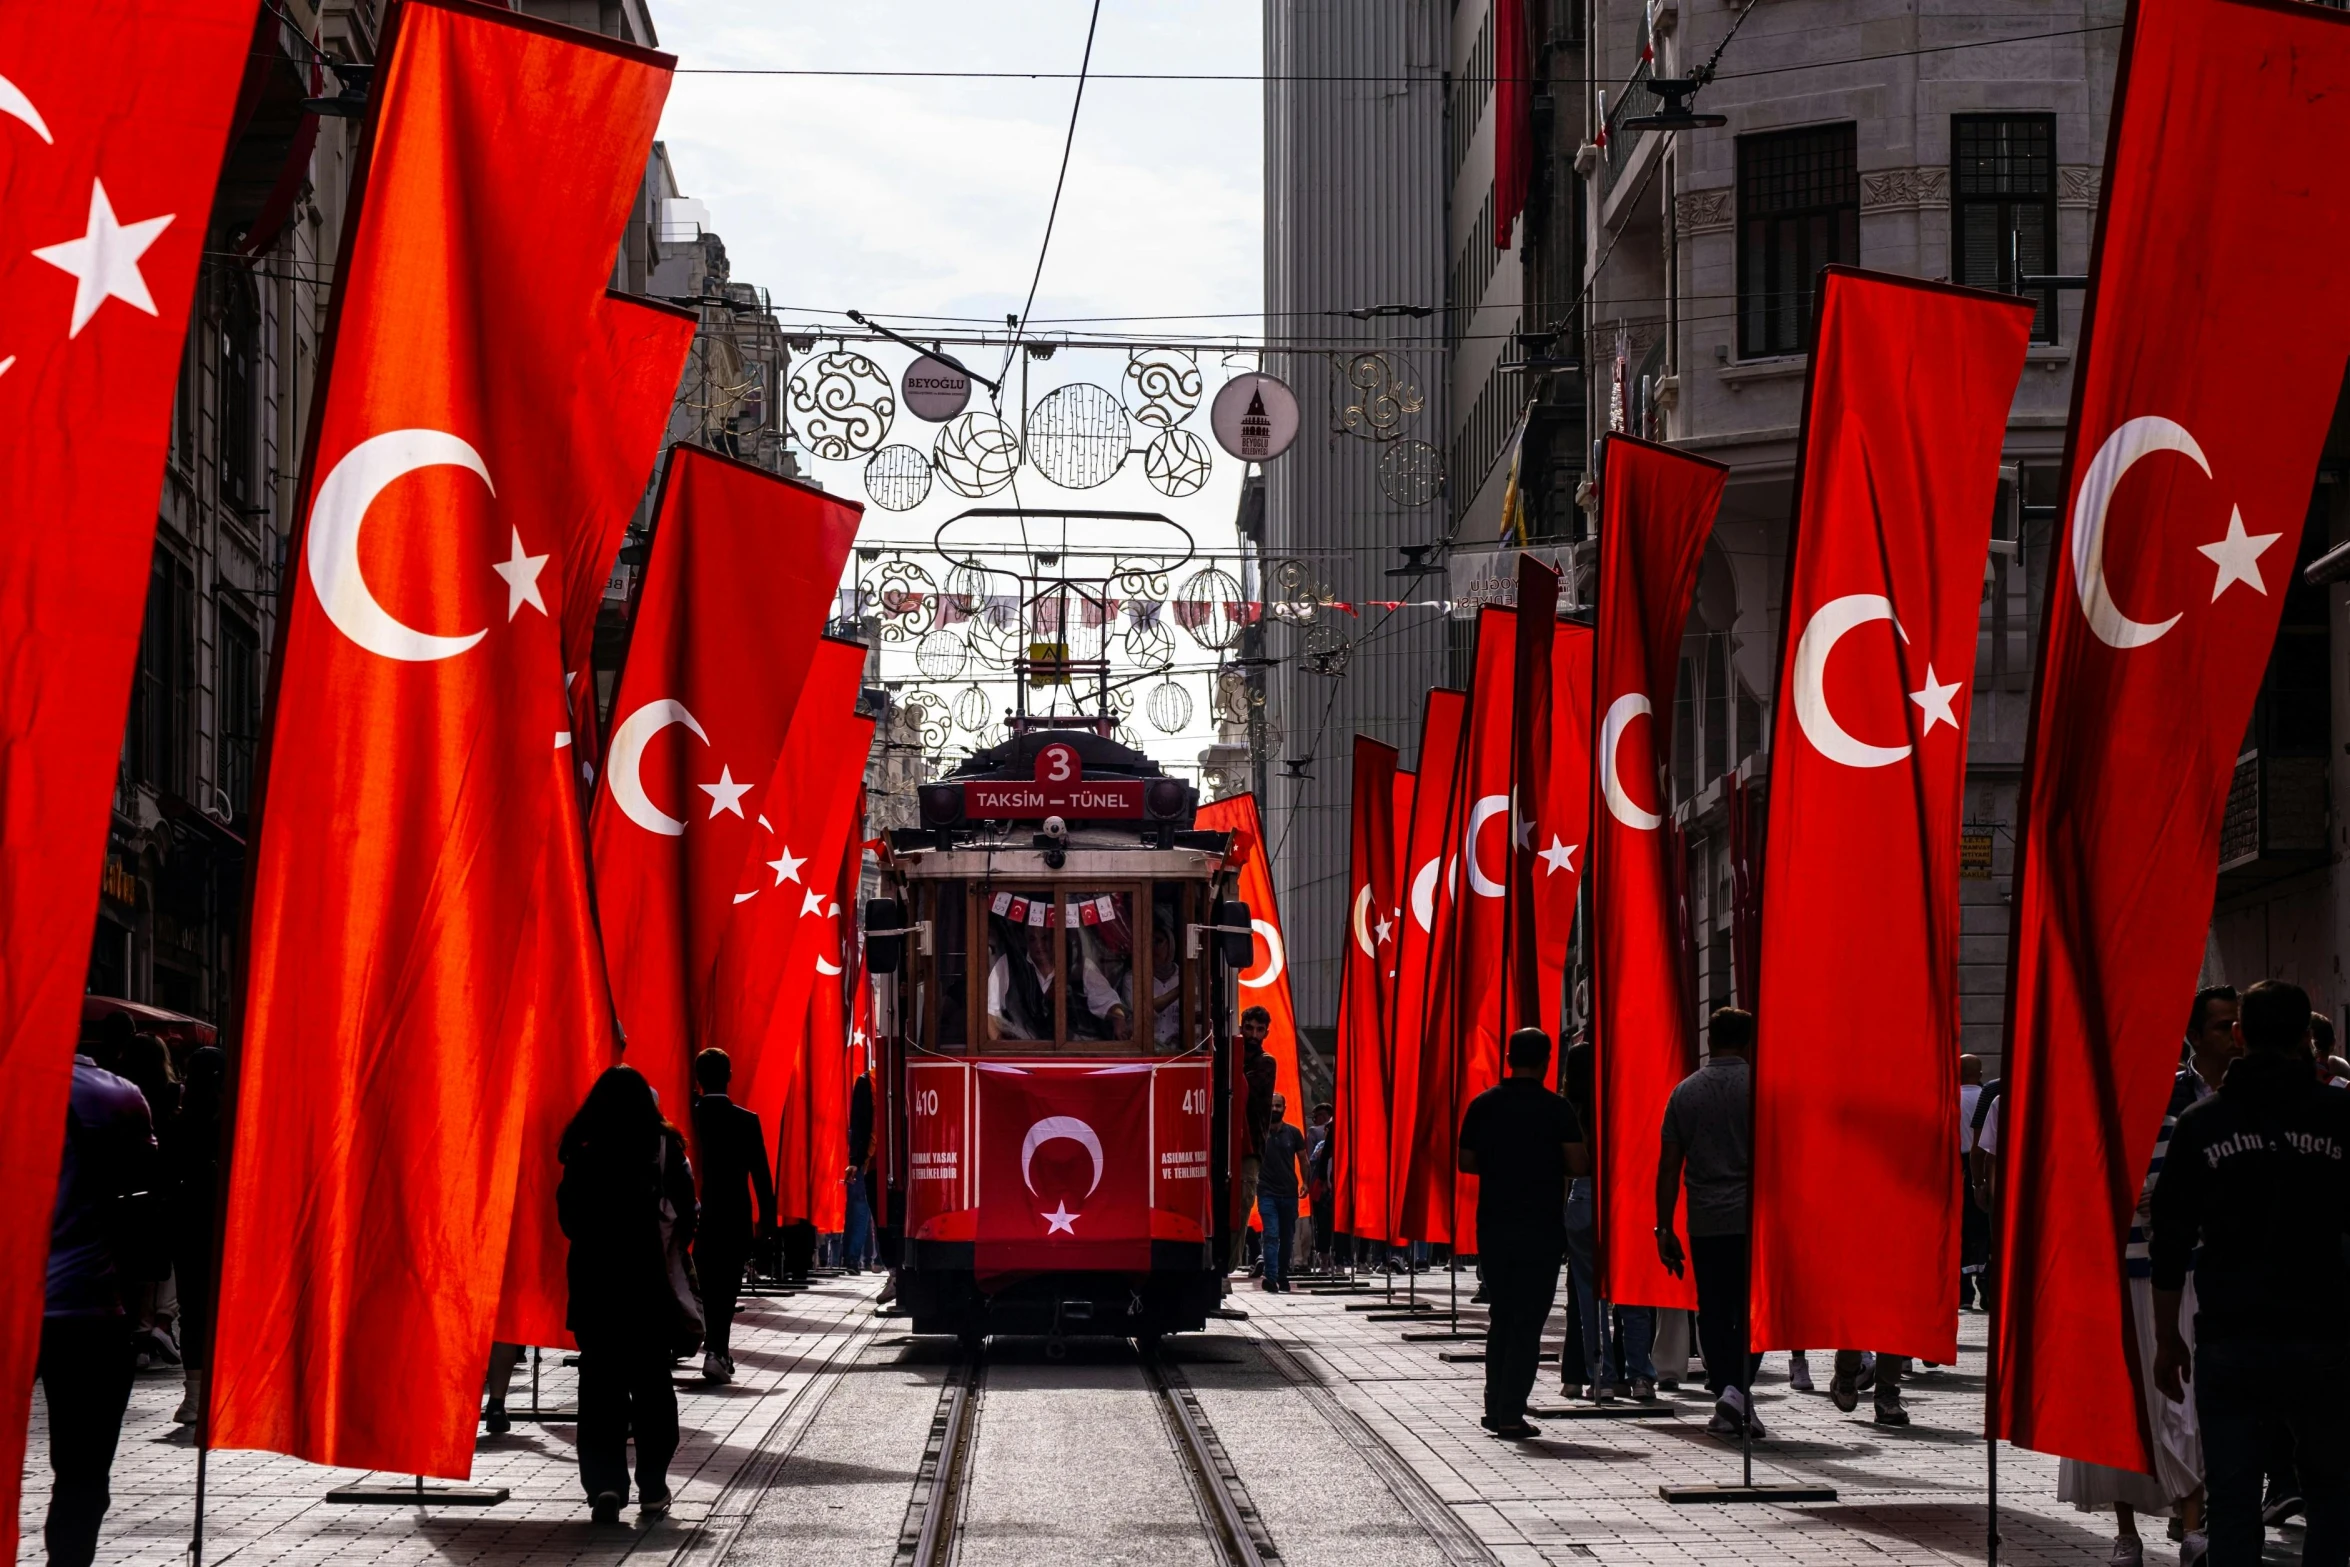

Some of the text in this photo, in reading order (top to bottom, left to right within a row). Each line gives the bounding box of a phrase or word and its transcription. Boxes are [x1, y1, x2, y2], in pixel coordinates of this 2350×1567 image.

[908, 377, 965, 390] BEYOĞLU
[1046, 748, 1071, 782] 3
[977, 790, 1044, 807] TAKSİM
[1069, 790, 1129, 808] TÜNEL
[916, 1089, 938, 1116] 410
[1182, 1088, 1206, 1115] 410
[932, 1152, 958, 1163] YASAK
[1161, 1152, 1194, 1165] ASILMAK
[2203, 1131, 2264, 1169] palm
[1162, 1168, 1173, 1180] VE
